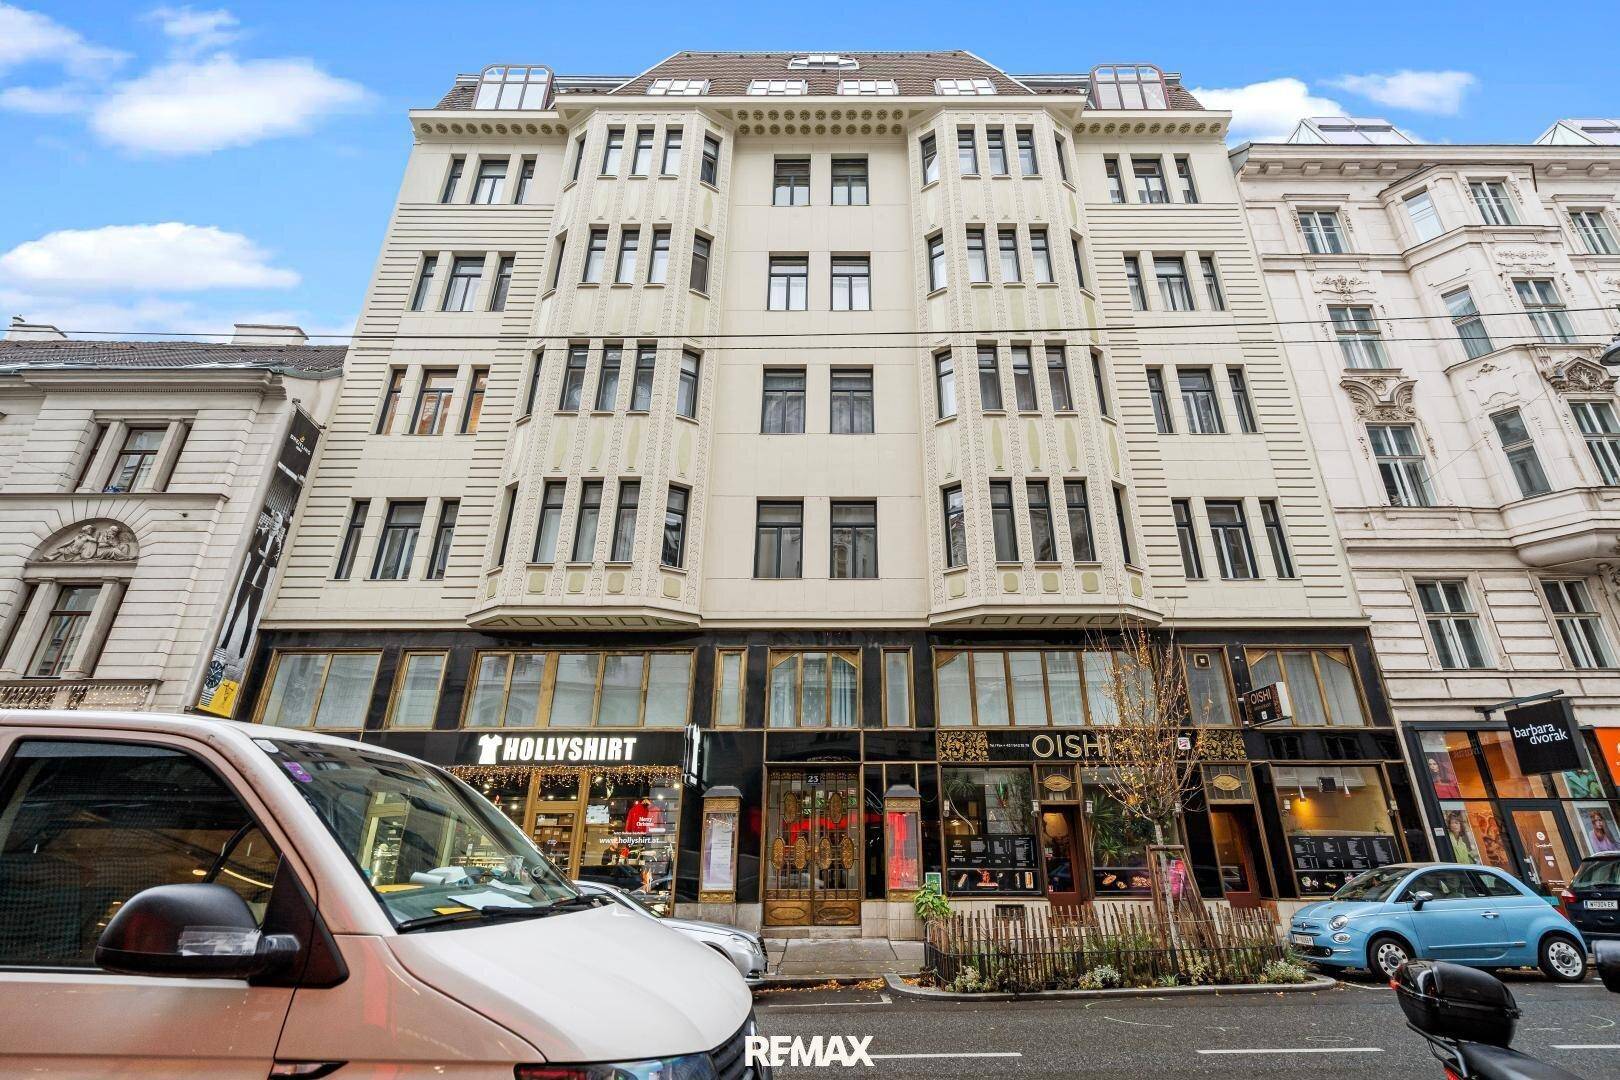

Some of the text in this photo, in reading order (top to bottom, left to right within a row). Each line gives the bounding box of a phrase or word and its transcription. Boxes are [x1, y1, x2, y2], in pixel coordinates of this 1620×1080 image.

[1250, 688, 1272, 705] OISHI
[1513, 724, 1555, 738] barbara
[1529, 728, 1569, 745] dvorak
[502, 737, 637, 761] HOLLYSHIRT
[1032, 734, 1111, 758] OISHI
[807, 775, 819, 783] 23
